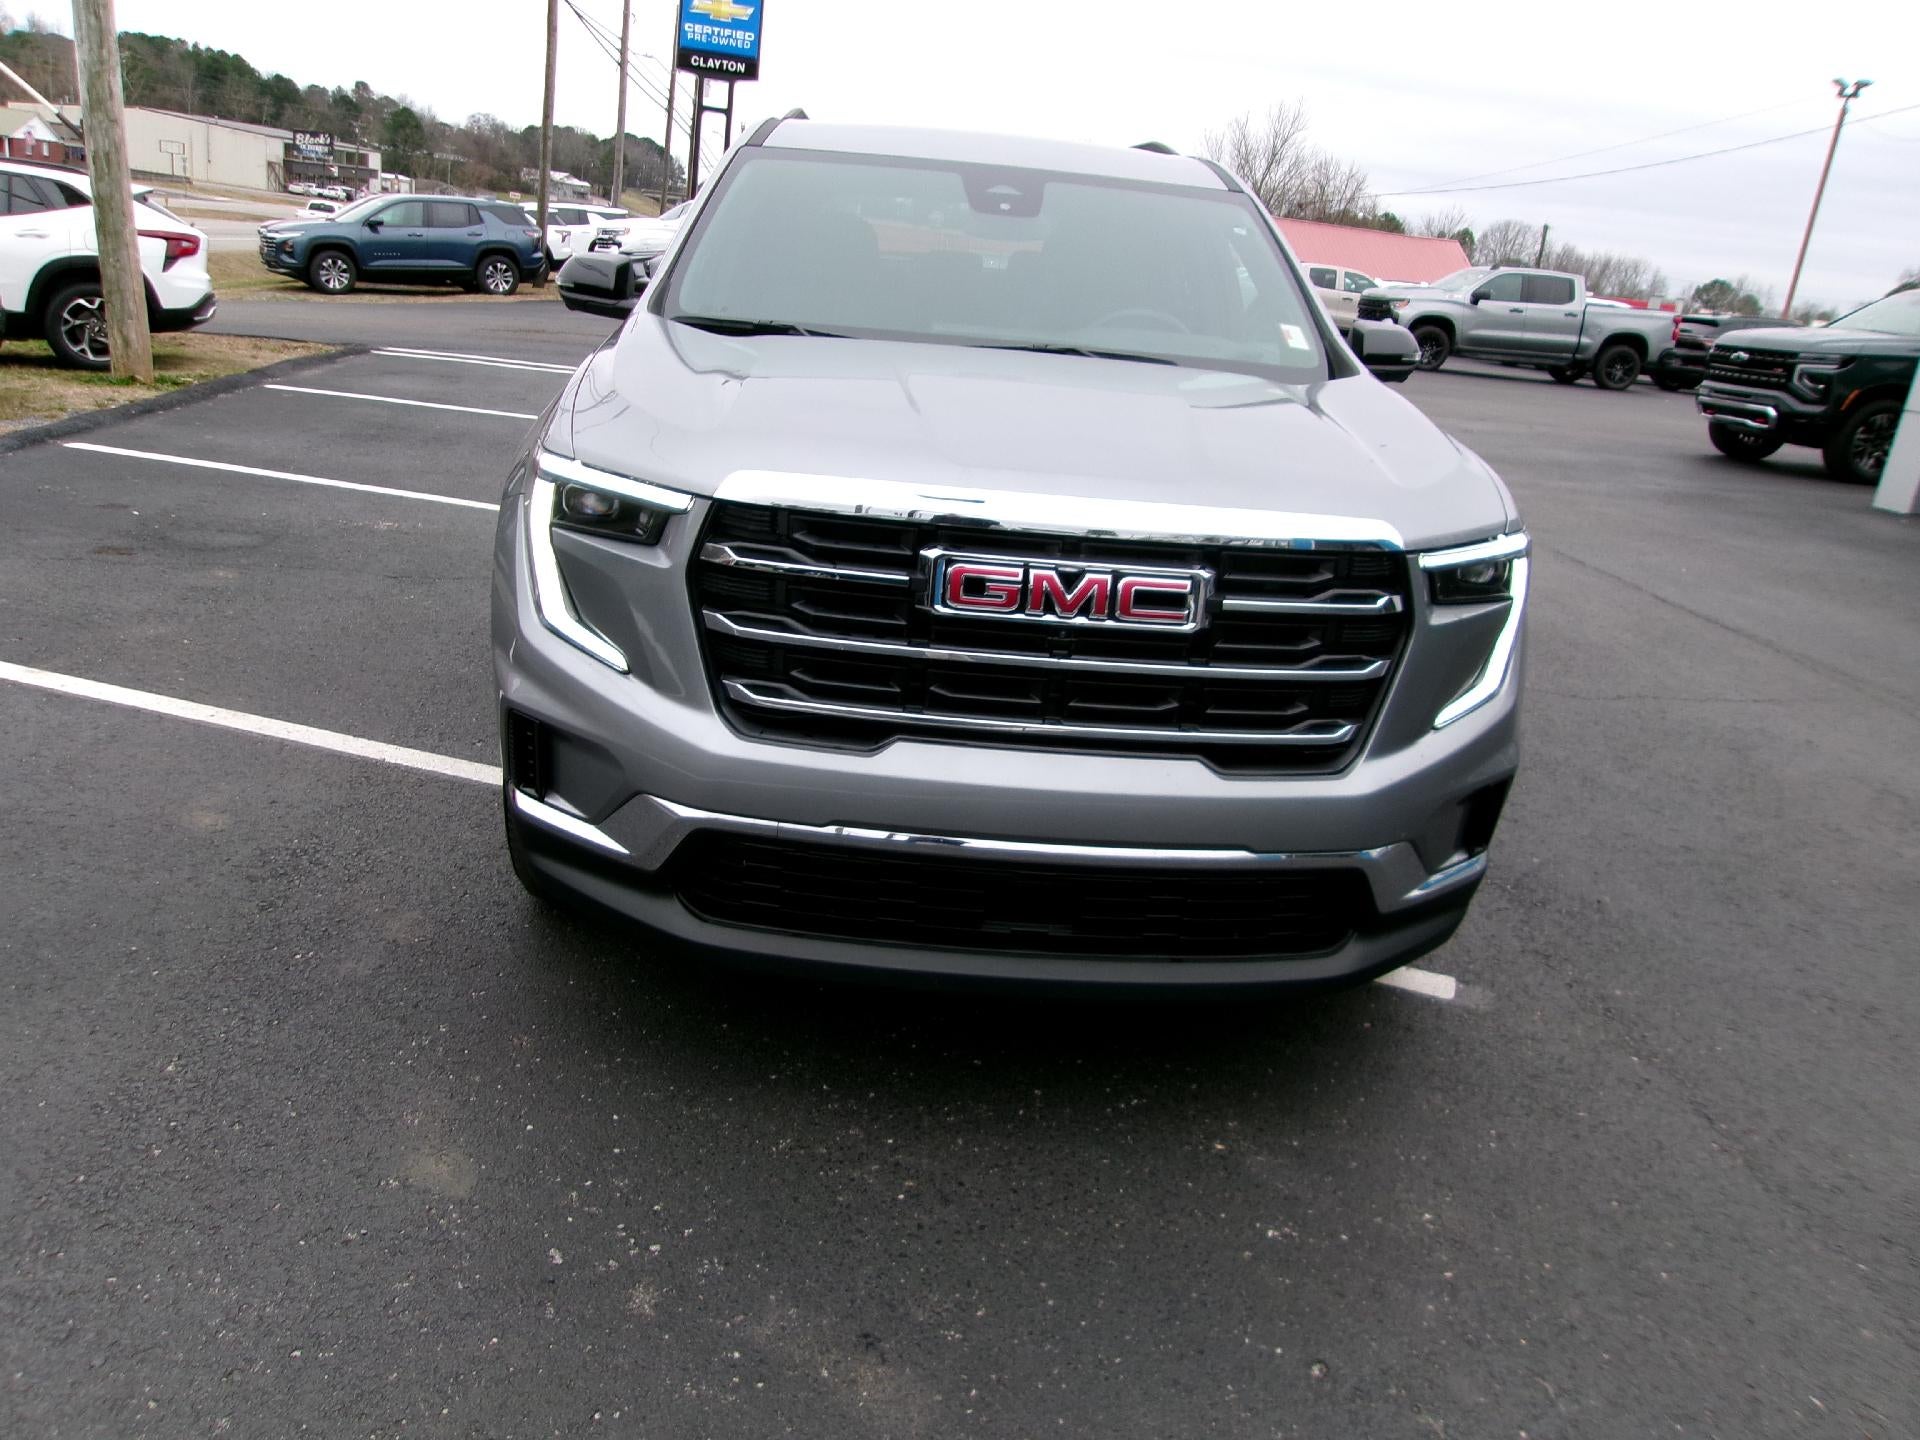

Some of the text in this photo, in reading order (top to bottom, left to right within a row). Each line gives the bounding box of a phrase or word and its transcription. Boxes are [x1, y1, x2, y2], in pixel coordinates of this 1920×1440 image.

[684, 22, 755, 41] CERTIFIED
[688, 33, 751, 49] PRE-OWNED
[691, 55, 746, 74] CLAYTON
[946, 564, 1191, 624] GMC
